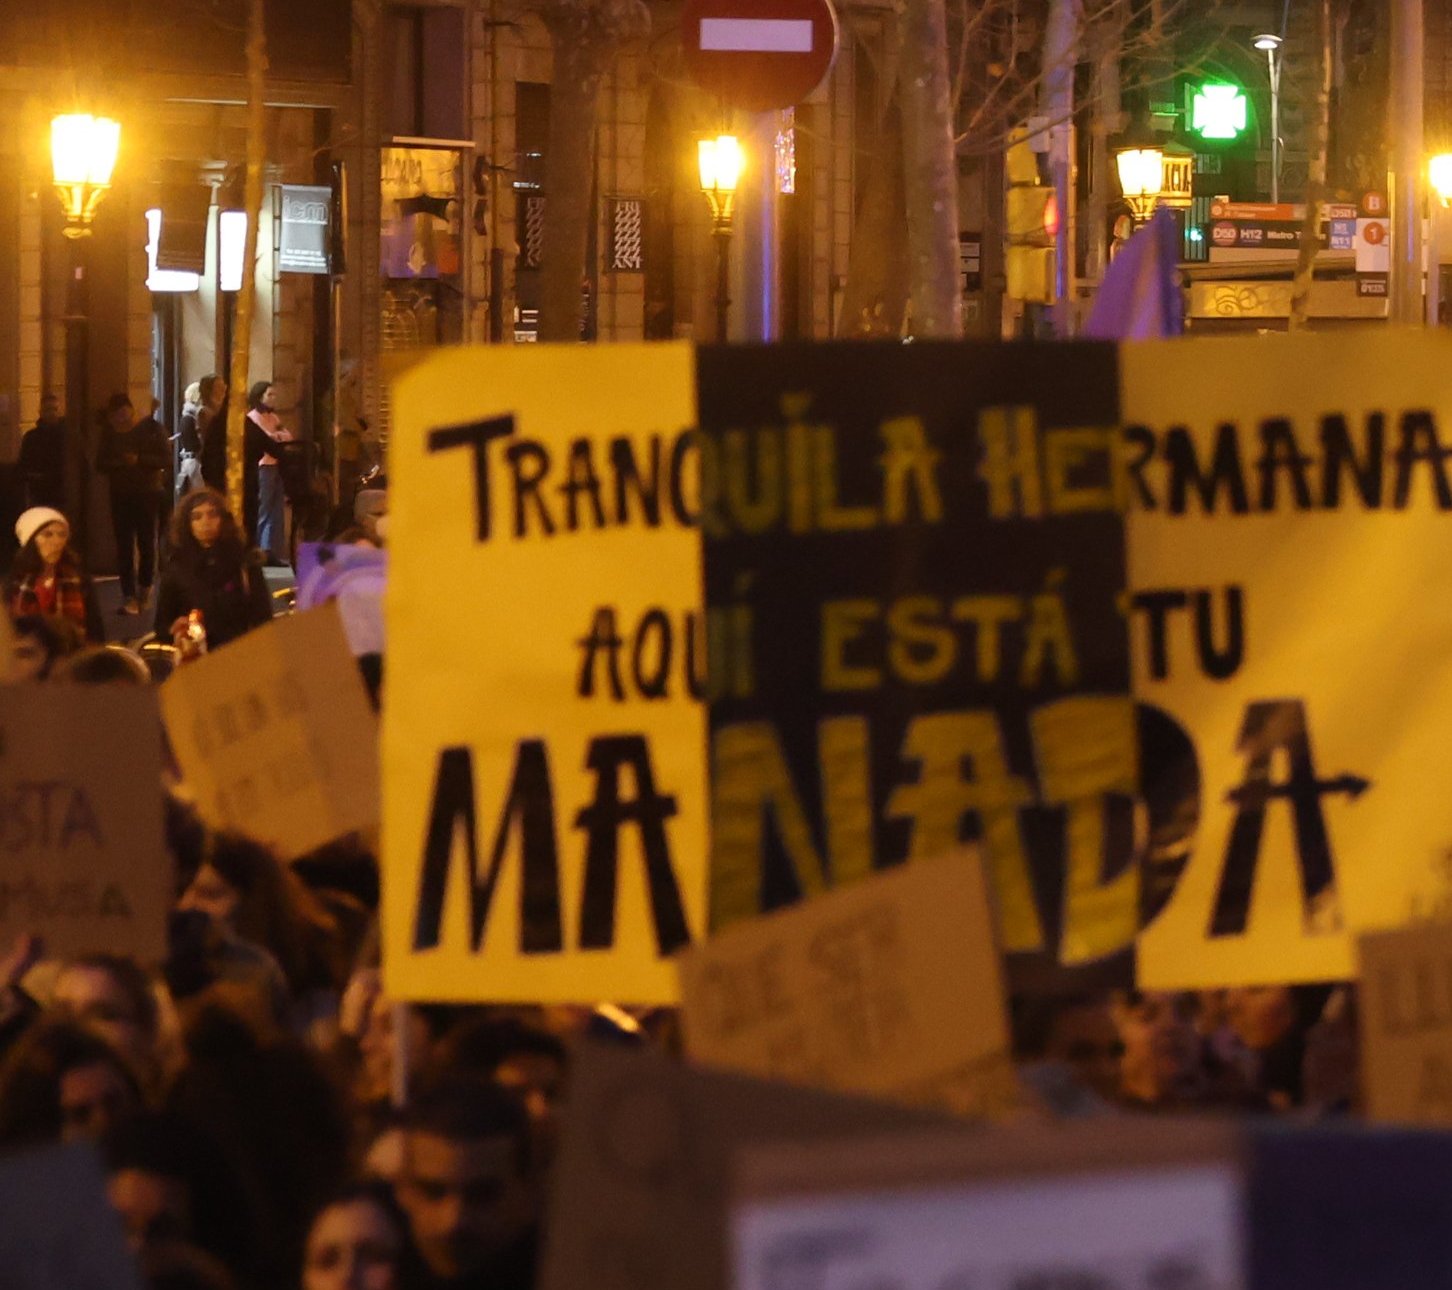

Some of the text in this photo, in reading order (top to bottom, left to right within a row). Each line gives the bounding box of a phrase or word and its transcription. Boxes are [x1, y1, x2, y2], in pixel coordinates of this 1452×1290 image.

[426, 392, 943, 545] TRANQUILA
[575, 567, 1245, 702] AQUÍ ESTÁ TU
[411, 693, 1373, 967] MANADA
